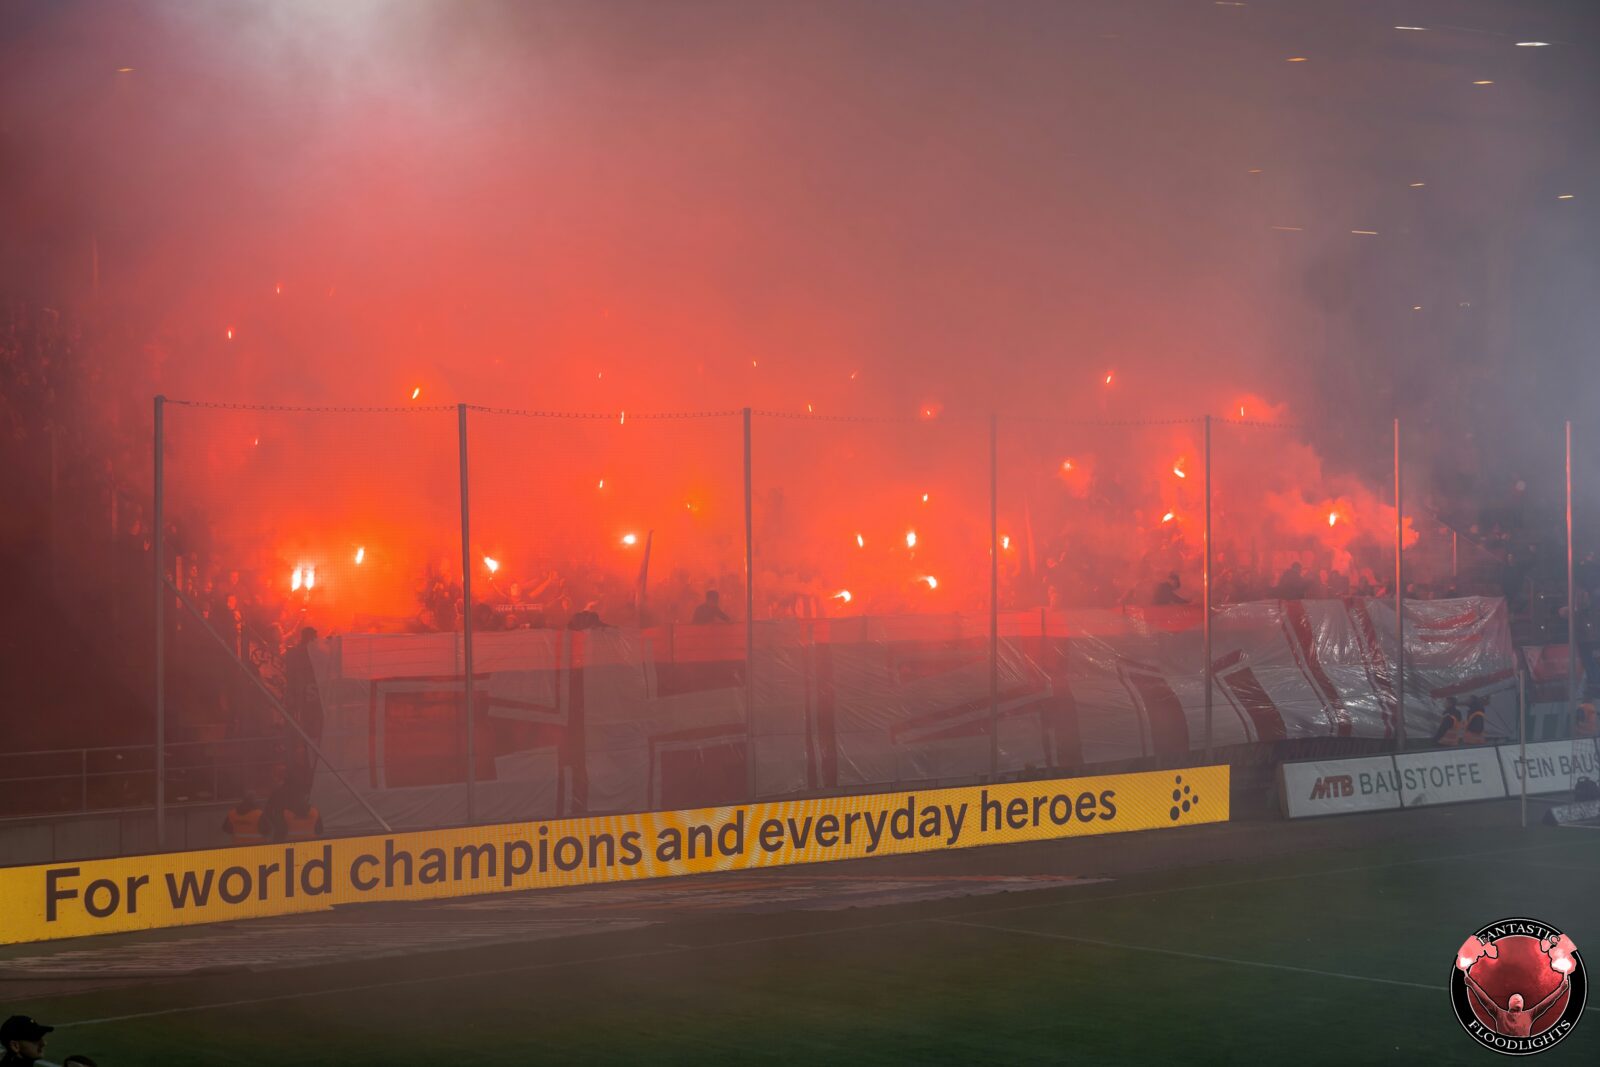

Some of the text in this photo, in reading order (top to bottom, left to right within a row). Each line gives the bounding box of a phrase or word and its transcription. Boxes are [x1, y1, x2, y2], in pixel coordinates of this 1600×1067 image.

[1309, 763, 1482, 800] MTB BAUSTOFFE
[1514, 756, 1555, 779] DEIN
[46, 789, 1117, 922] For world champions and everyday heroes
